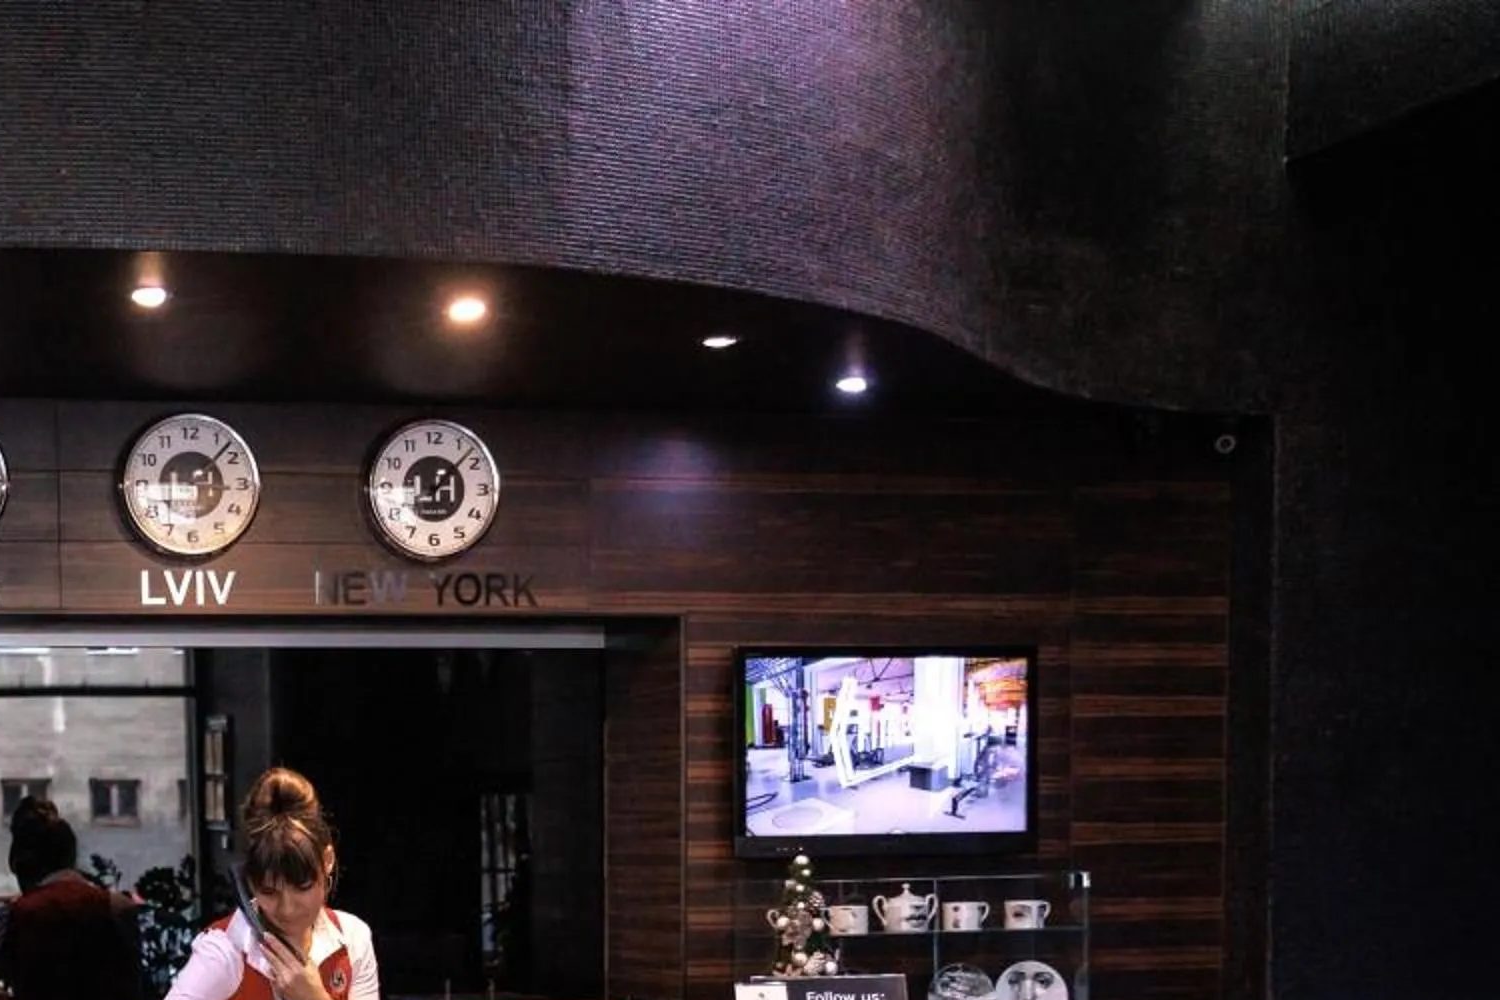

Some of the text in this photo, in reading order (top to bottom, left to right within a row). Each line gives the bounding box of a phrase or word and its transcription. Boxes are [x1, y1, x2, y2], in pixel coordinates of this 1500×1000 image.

[182, 427, 199, 440] 12
[426, 432, 444, 445] 12
[158, 435, 171, 448] 11
[404, 439, 416, 452] 11
[140, 453, 157, 466] 10
[227, 451, 239, 464] 2
[386, 457, 401, 470] 10
[469, 457, 480, 470] 2
[236, 477, 249, 490] 3
[476, 483, 489, 496] 3
[227, 503, 241, 516] 4
[467, 507, 481, 520] 4
[162, 523, 174, 536] 7
[404, 525, 417, 538] 7
[453, 526, 465, 538] 5
[187, 530, 198, 543] 6
[428, 533, 441, 546] 6
[142, 570, 235, 605] LVIV
[430, 572, 540, 607] YORK
